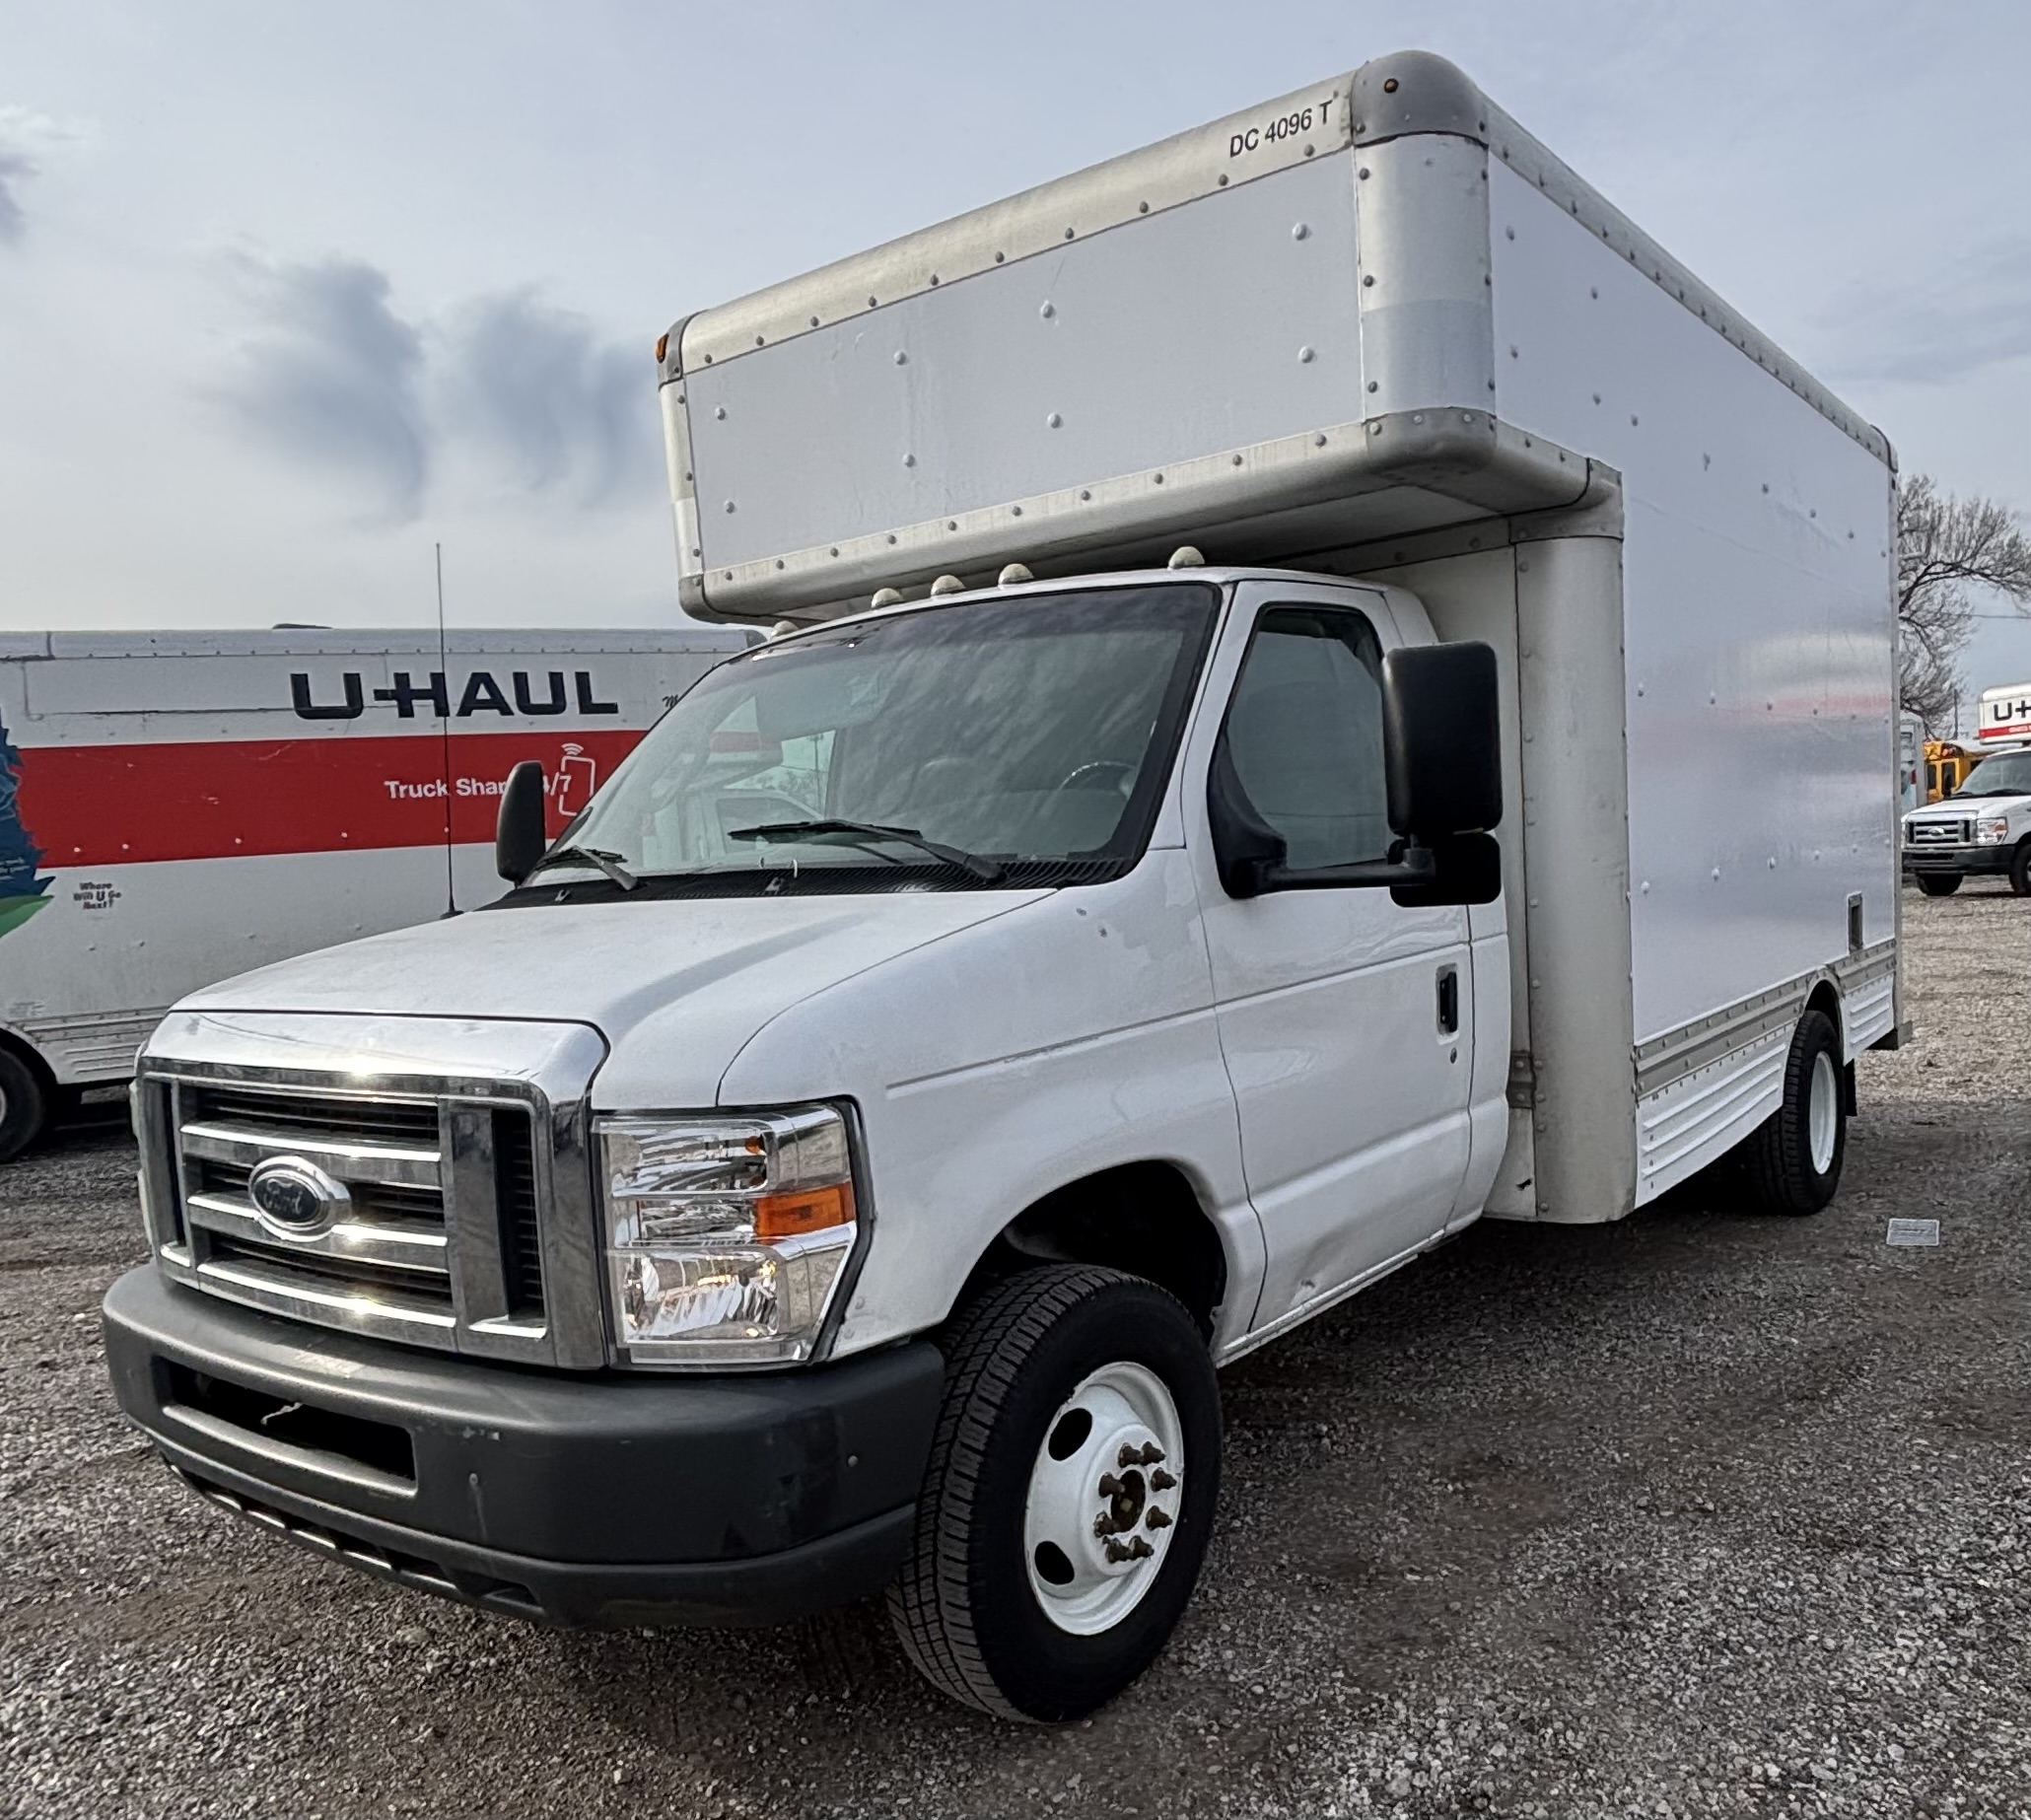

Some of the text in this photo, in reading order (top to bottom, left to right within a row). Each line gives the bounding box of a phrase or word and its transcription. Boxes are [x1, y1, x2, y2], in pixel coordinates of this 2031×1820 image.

[1229, 99, 1333, 158] DC 4096 T
[290, 670, 619, 721] U-HAUL
[384, 771, 572, 800] Truck Shar /7
